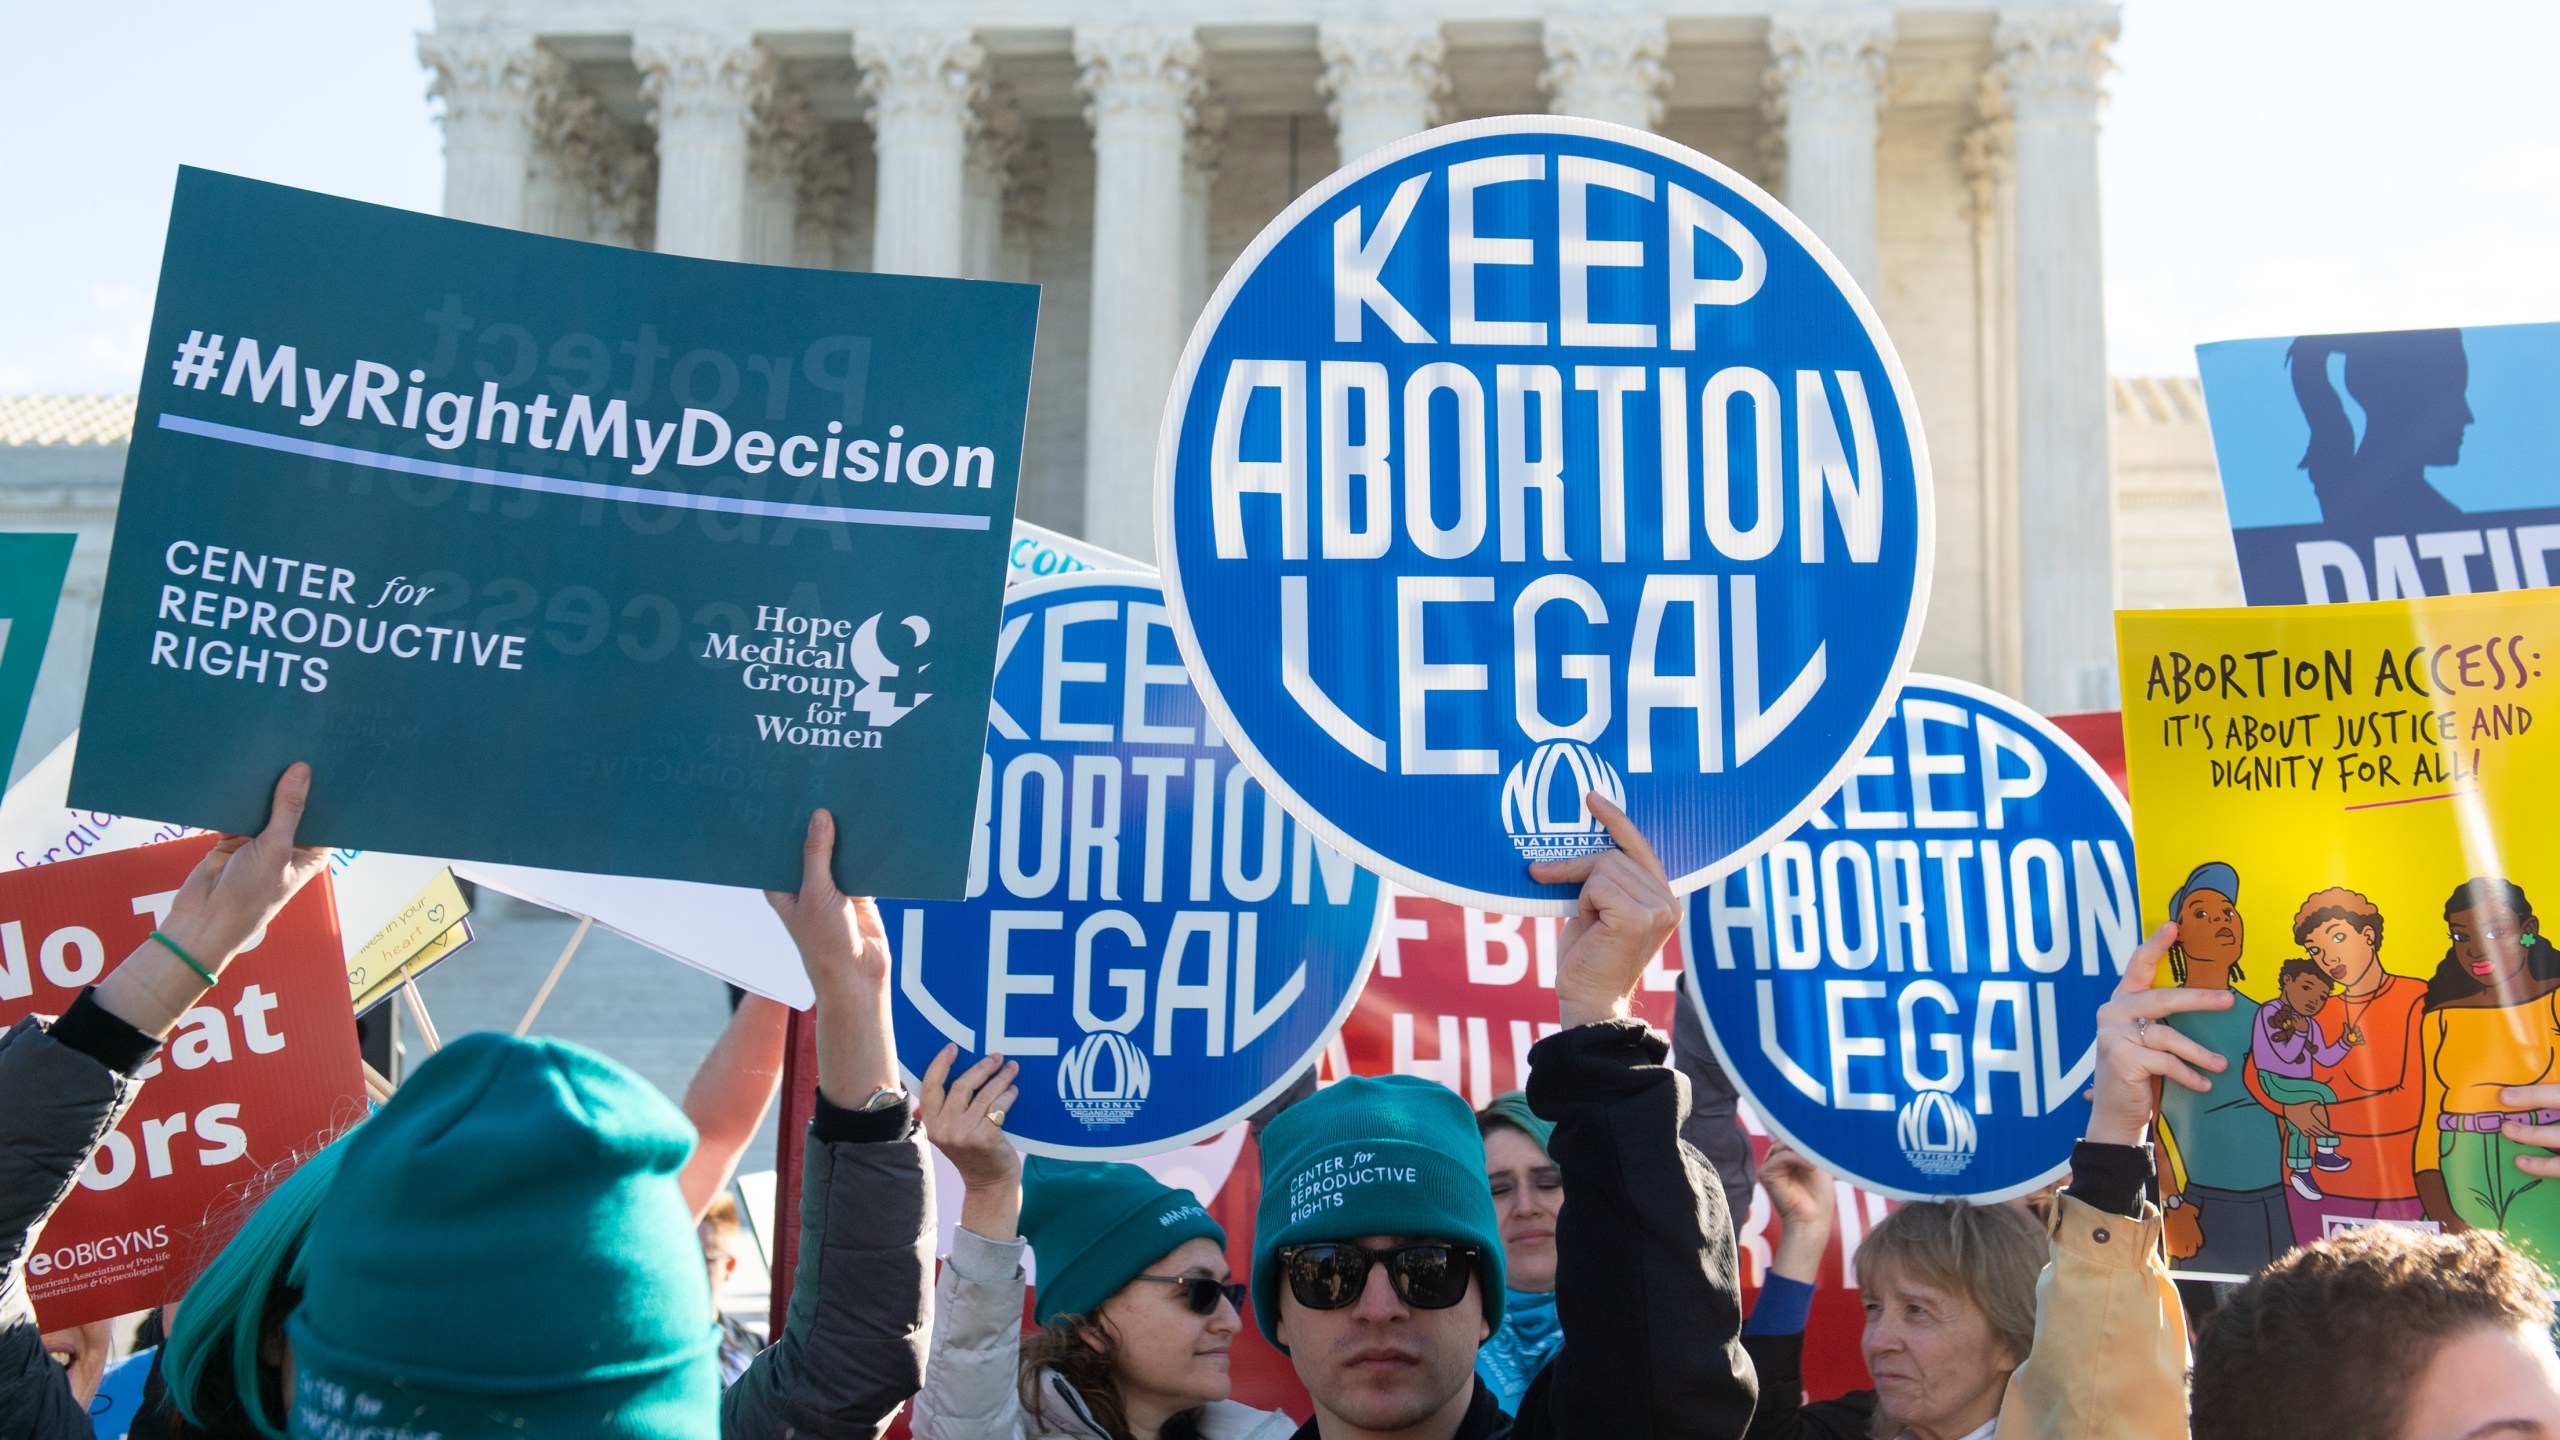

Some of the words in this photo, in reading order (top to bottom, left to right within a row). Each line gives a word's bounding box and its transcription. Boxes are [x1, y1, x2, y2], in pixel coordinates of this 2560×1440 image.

[1334, 154, 1767, 351] KEEP
[172, 330, 994, 489] #MyRightMyDecision
[1211, 359, 1883, 563] ABORTION
[165, 540, 356, 604] CENTER
[368, 576, 434, 609] for
[158, 585, 526, 670] REPRODUCTIVE
[701, 632, 845, 670] Medical
[754, 605, 852, 648] Hope
[151, 631, 329, 693] RIGHTS
[742, 663, 856, 709] Group
[989, 600, 1223, 747] KEE
[1281, 573, 1826, 774] LEGAL
[2147, 649, 2352, 704] ABORTION
[2374, 635, 2541, 697] ACCESS:
[754, 714, 883, 748] Women
[806, 702, 847, 725] for
[2163, 713, 2214, 750] IT'S
[2225, 713, 2320, 751] ABOUT
[2332, 709, 2457, 750] JUSTICE
[2471, 703, 2533, 741] AND
[1502, 743, 1626, 834] NOW
[1808, 699, 2048, 830] EEP
[2211, 754, 2324, 791] DIGNITY
[2337, 753, 2400, 792] FOR
[2413, 748, 2481, 787] ALL!
[1513, 837, 1616, 847] NATIONAL
[1709, 837, 2138, 977] ABORTION
[382, 926, 423, 962] heart
[901, 908, 1305, 1057] LEGAL
[1057, 1033, 1151, 1099] NOW
[1755, 979, 2097, 1118] LEGAL
[1064, 1101, 1141, 1109] NATIONAL
[1897, 1091, 1977, 1153] NOW
[1290, 1156, 1344, 1193] CENTER
[1349, 1152, 1375, 1168] for
[1290, 1167, 1416, 1209] REPRODUCTIVE
[1290, 1192, 1343, 1225] RIGHTS
[72, 1264, 125, 1282] Association
[136, 1252, 171, 1267] Pro-life
